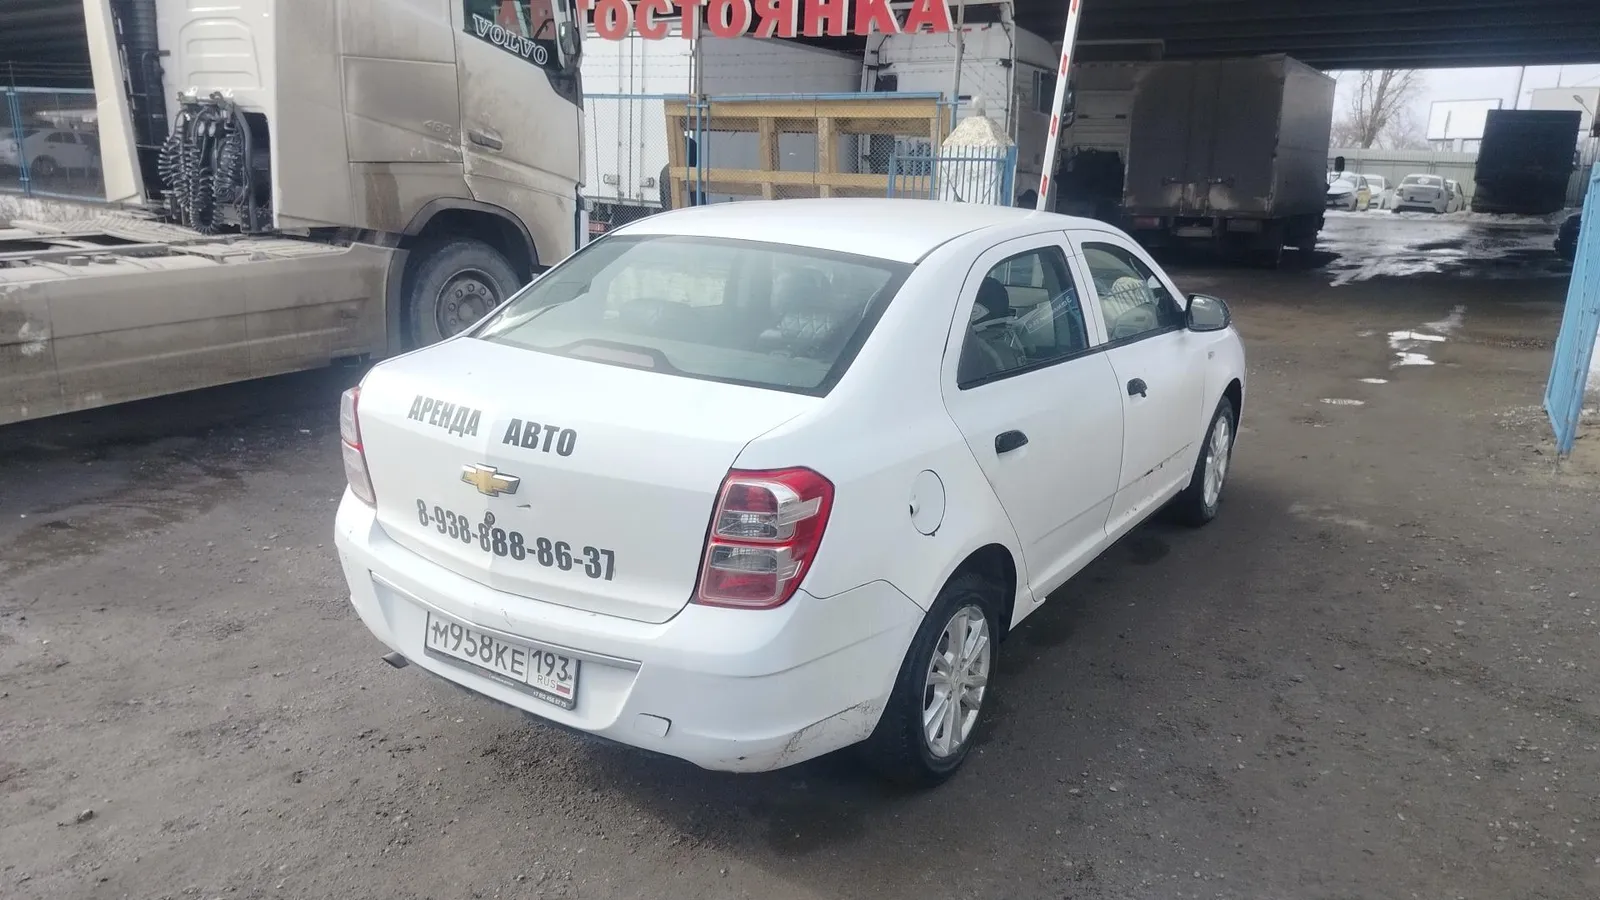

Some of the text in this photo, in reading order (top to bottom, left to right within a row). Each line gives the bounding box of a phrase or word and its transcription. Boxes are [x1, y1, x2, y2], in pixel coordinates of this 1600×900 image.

[472, 13, 548, 65] VOLVO
[407, 394, 577, 457] АРЕНДА АВТО
[416, 498, 615, 581] 8-938-888-86-37
[531, 650, 569, 682] 193
[537, 675, 556, 689] RUS
